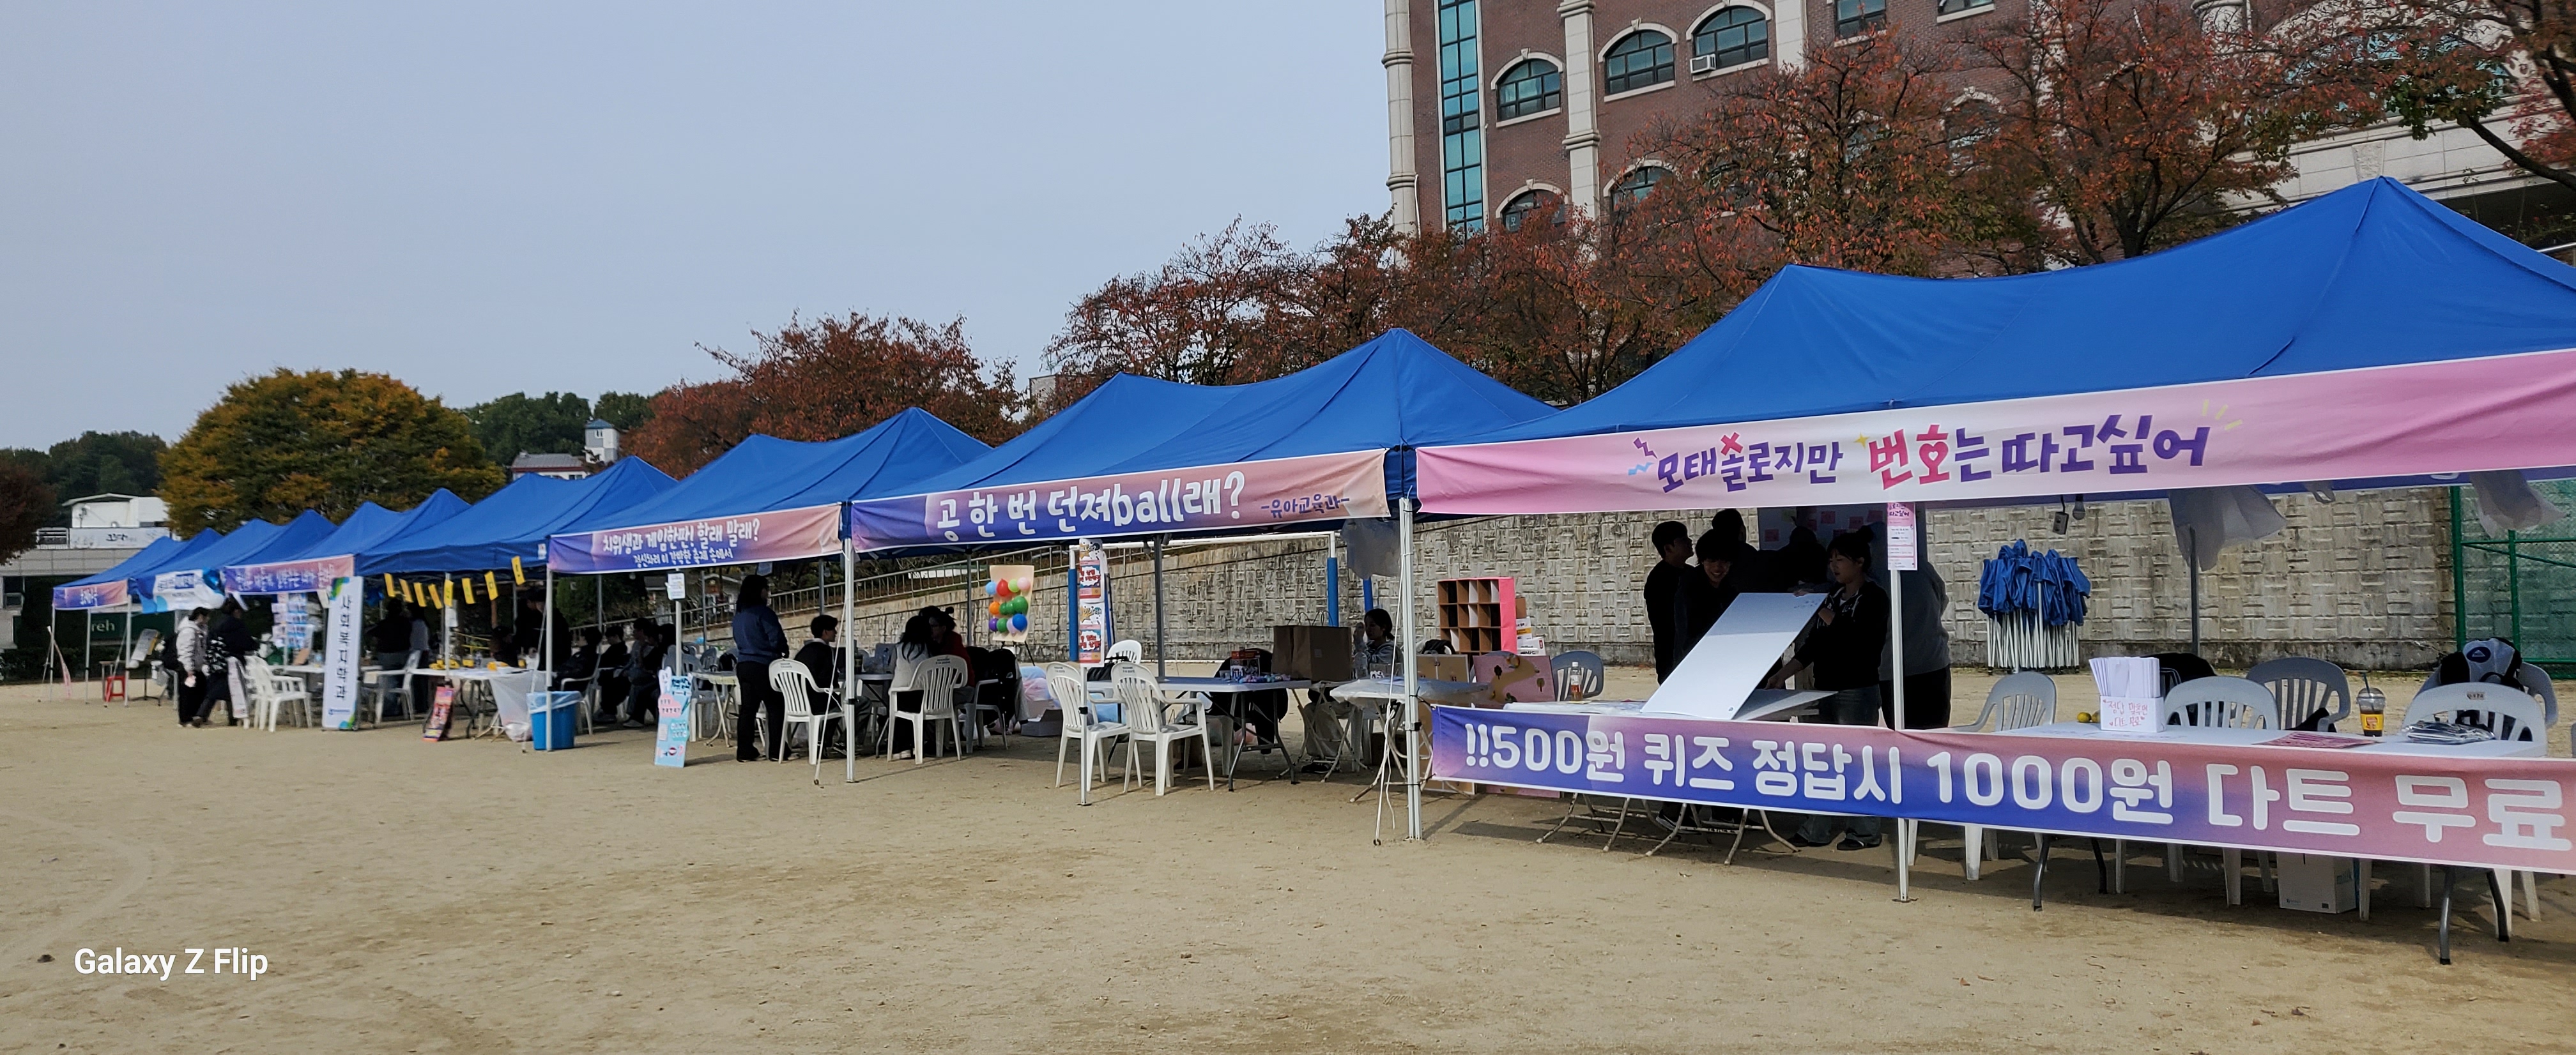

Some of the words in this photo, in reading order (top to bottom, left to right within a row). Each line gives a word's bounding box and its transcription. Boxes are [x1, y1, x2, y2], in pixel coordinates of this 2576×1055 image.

[1657, 432, 1844, 494] 모태솔로지만
[1868, 423, 1993, 490] 번호는
[2002, 414, 2211, 476] 따고싶어
[937, 497, 960, 542] 공
[967, 491, 999, 538] 한
[1008, 489, 1036, 535] 번
[1047, 471, 1246, 533] 던져ball래?
[1261, 493, 1350, 519] -유아교육과-
[602, 532, 643, 555] 치위생과
[645, 525, 694, 552] 게임한판!
[697, 522, 723, 549] 할래
[726, 518, 760, 547] 말래?
[661, 553, 669, 563] 이
[693, 547, 709, 565] 축제
[709, 547, 733, 563] 속에서
[2107, 701, 2125, 715] 정답
[1464, 722, 1625, 782] !!500원
[1644, 732, 1735, 791] 퀴즈
[1752, 739, 1903, 805] 정답시
[1926, 750, 2174, 826] 1000원
[2205, 763, 2361, 837] 다트
[2391, 773, 2573, 853] 무료
